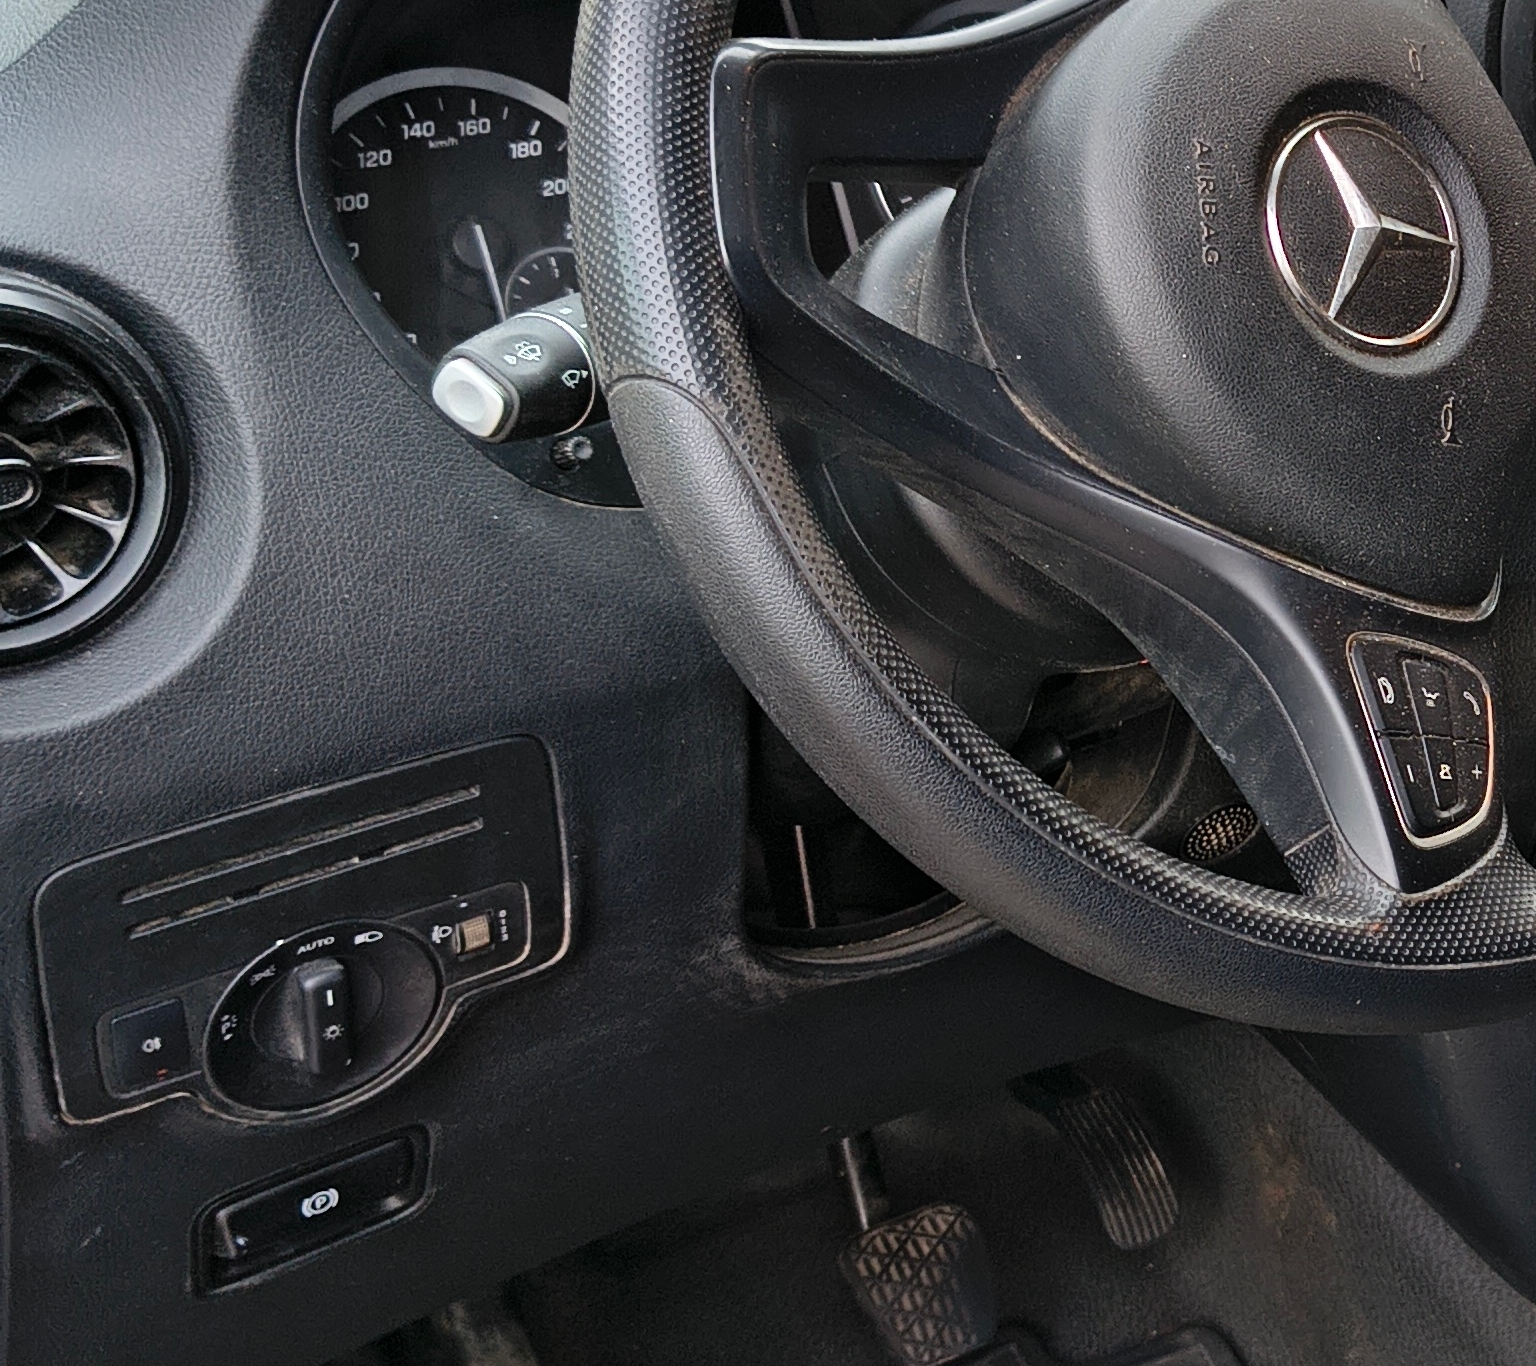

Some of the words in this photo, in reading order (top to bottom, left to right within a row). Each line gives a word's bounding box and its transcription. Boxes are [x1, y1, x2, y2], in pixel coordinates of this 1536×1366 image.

[401, 121, 436, 140] 140
[457, 119, 491, 136] 160
[428, 137, 459, 149] km/h
[509, 140, 543, 159] 180
[357, 149, 392, 169] 120
[542, 178, 570, 197] 20
[335, 192, 370, 212] 100
[1193, 138, 1220, 266] AIRBAG
[297, 936, 335, 955] AUTO
